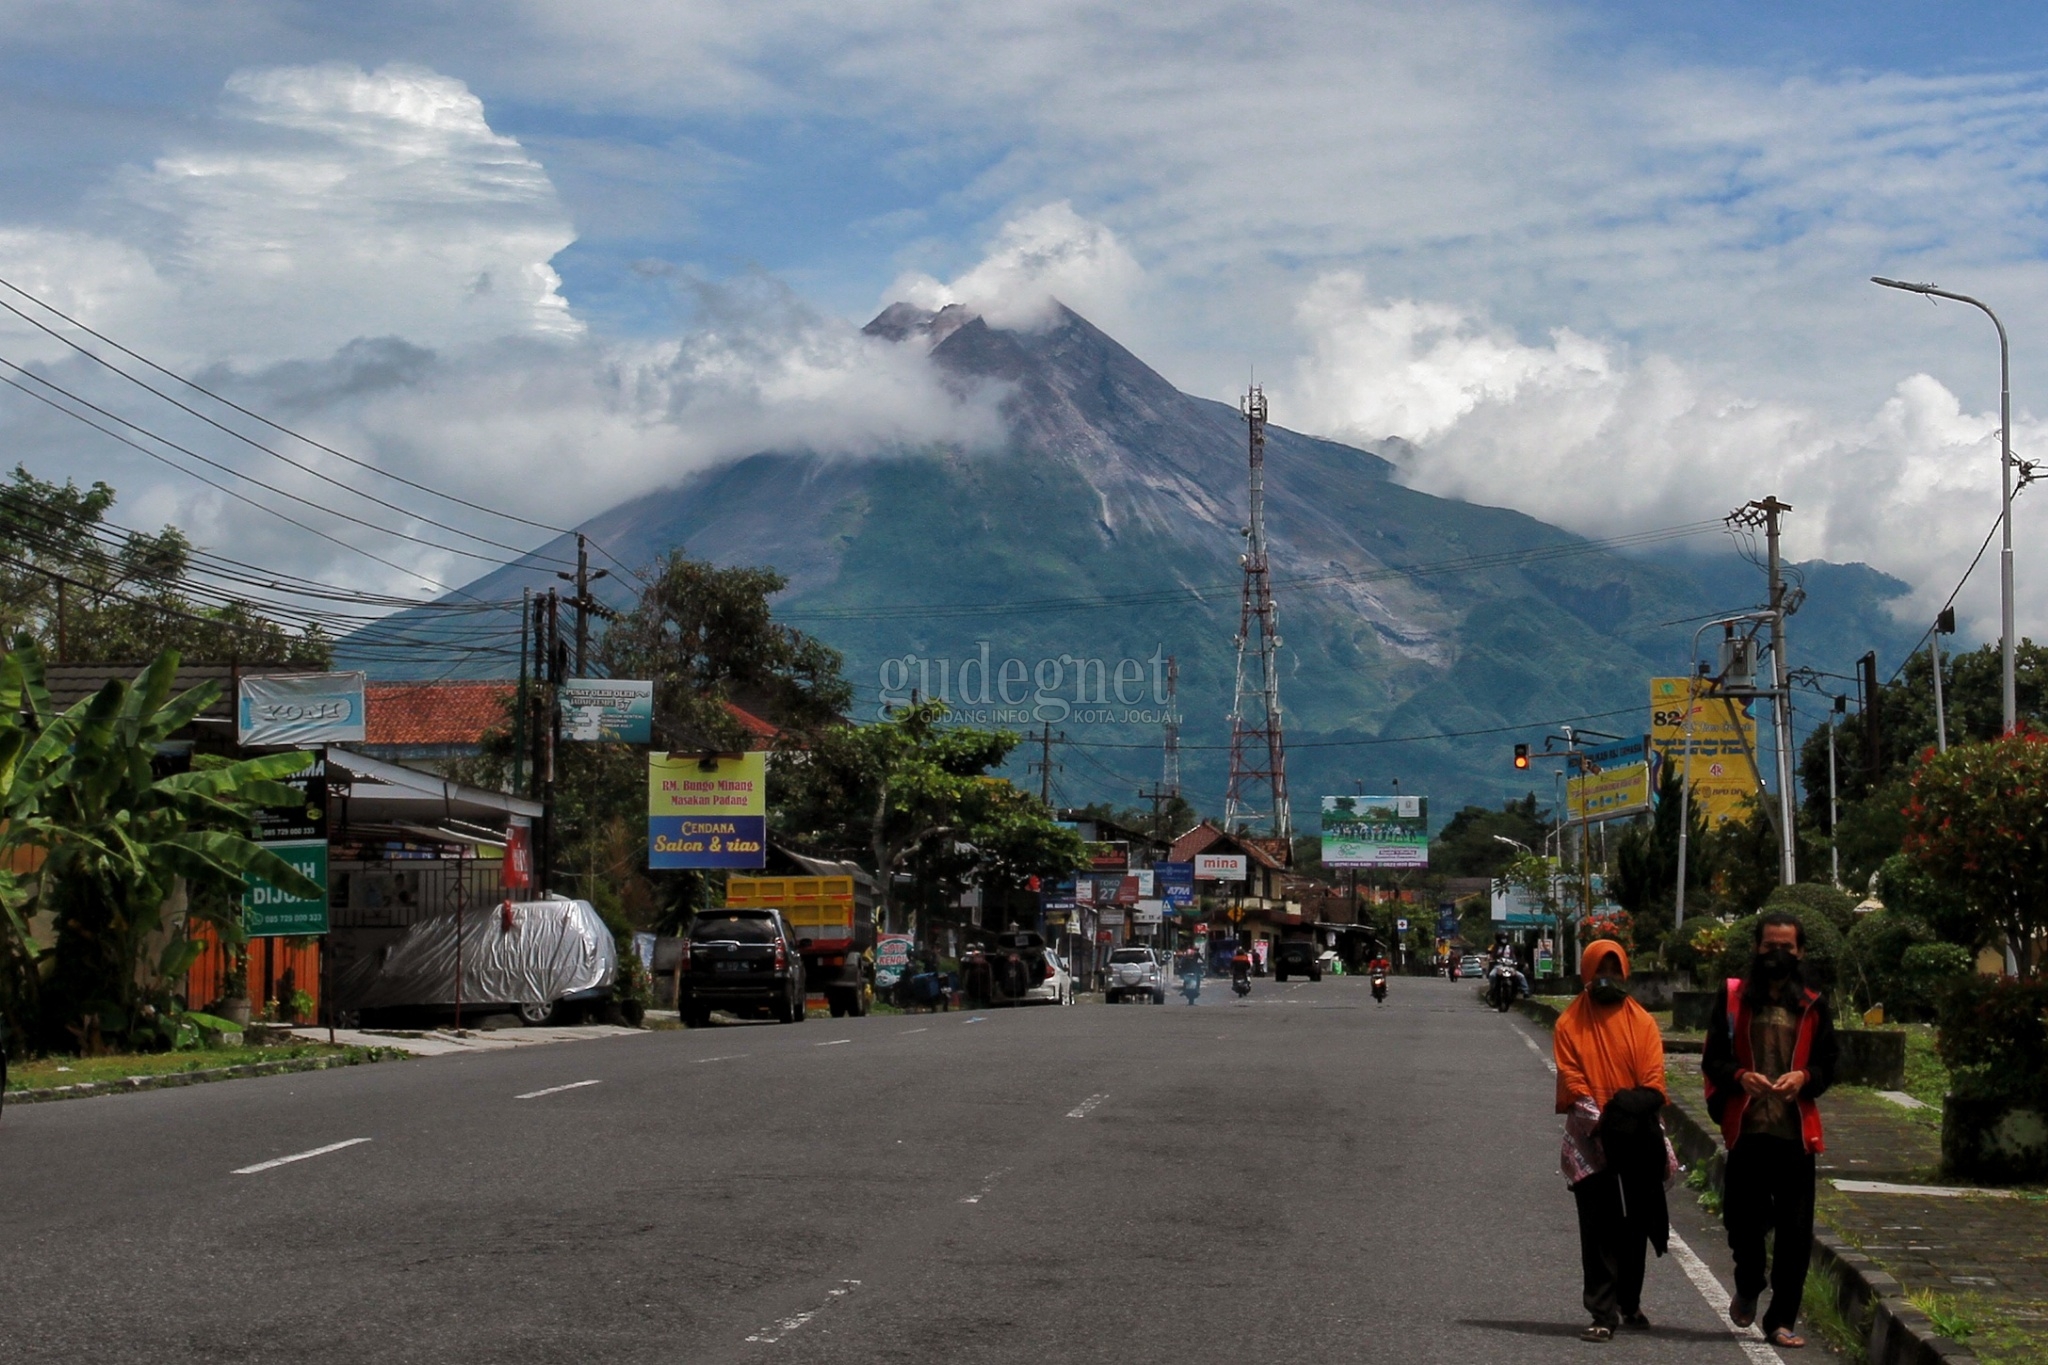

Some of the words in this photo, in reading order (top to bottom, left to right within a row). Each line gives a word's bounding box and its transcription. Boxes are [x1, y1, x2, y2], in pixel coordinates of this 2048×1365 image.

[566, 689, 590, 697] PUSAT
[591, 690, 613, 698] OLEH
[614, 690, 636, 699] OLEH
[1653, 711, 1682, 727] 82
[662, 780, 680, 791] RM.
[683, 780, 714, 792] Bungo
[718, 780, 754, 792] Minang
[671, 795, 710, 806] Masakan
[713, 795, 749, 807] Padang
[654, 835, 704, 853] Salon
[709, 836, 722, 852] &
[727, 838, 761, 853] rias
[1204, 857, 1238, 868] mina
[1099, 888, 1117, 900] 27
[1167, 886, 1191, 895] ATM
